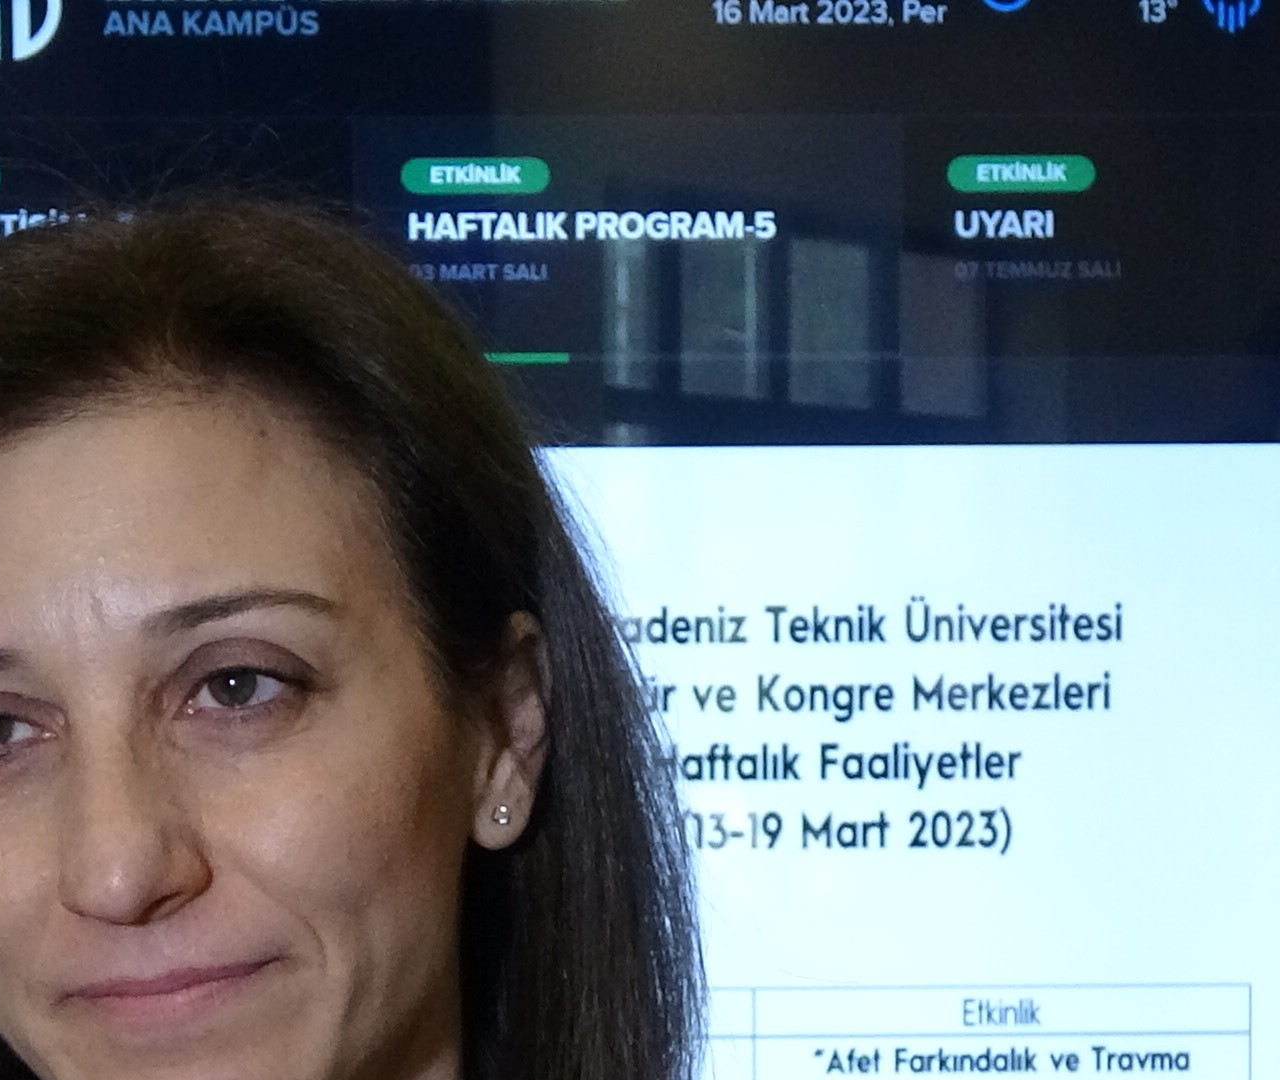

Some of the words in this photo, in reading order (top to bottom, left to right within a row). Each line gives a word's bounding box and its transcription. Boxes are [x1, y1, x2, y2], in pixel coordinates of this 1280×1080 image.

[104, 9, 174, 37] ANA
[182, 4, 320, 36] KAMPÜS
[713, 0, 743, 25] 16
[749, 0, 810, 24] Mart
[817, 0, 895, 27] 2023,
[902, 0, 948, 24] Per
[429, 162, 521, 184] ETKİNLİK
[975, 160, 1067, 183] ETKİNLİK
[407, 211, 568, 241] HAFTALIK
[575, 210, 777, 240] PROGRAM-5
[954, 208, 1056, 239] UYARI
[439, 263, 499, 281] MART
[502, 262, 548, 281] SALI
[615, 605, 748, 644] adeniz
[765, 605, 886, 643] Teknik
[905, 596, 1123, 644] Üniversitesi
[693, 684, 737, 712] ve
[757, 674, 894, 722] Kongre
[913, 672, 1111, 711] Merkezleri
[820, 742, 1022, 789] Faaliyetler
[801, 811, 890, 849] Mart
[909, 806, 1014, 854] 2023)
[963, 998, 1040, 1026] Etkinlik
[894, 1046, 1037, 1073] Farkındalık
[1050, 1052, 1080, 1072] ve
[1092, 1046, 1190, 1072] Travma
